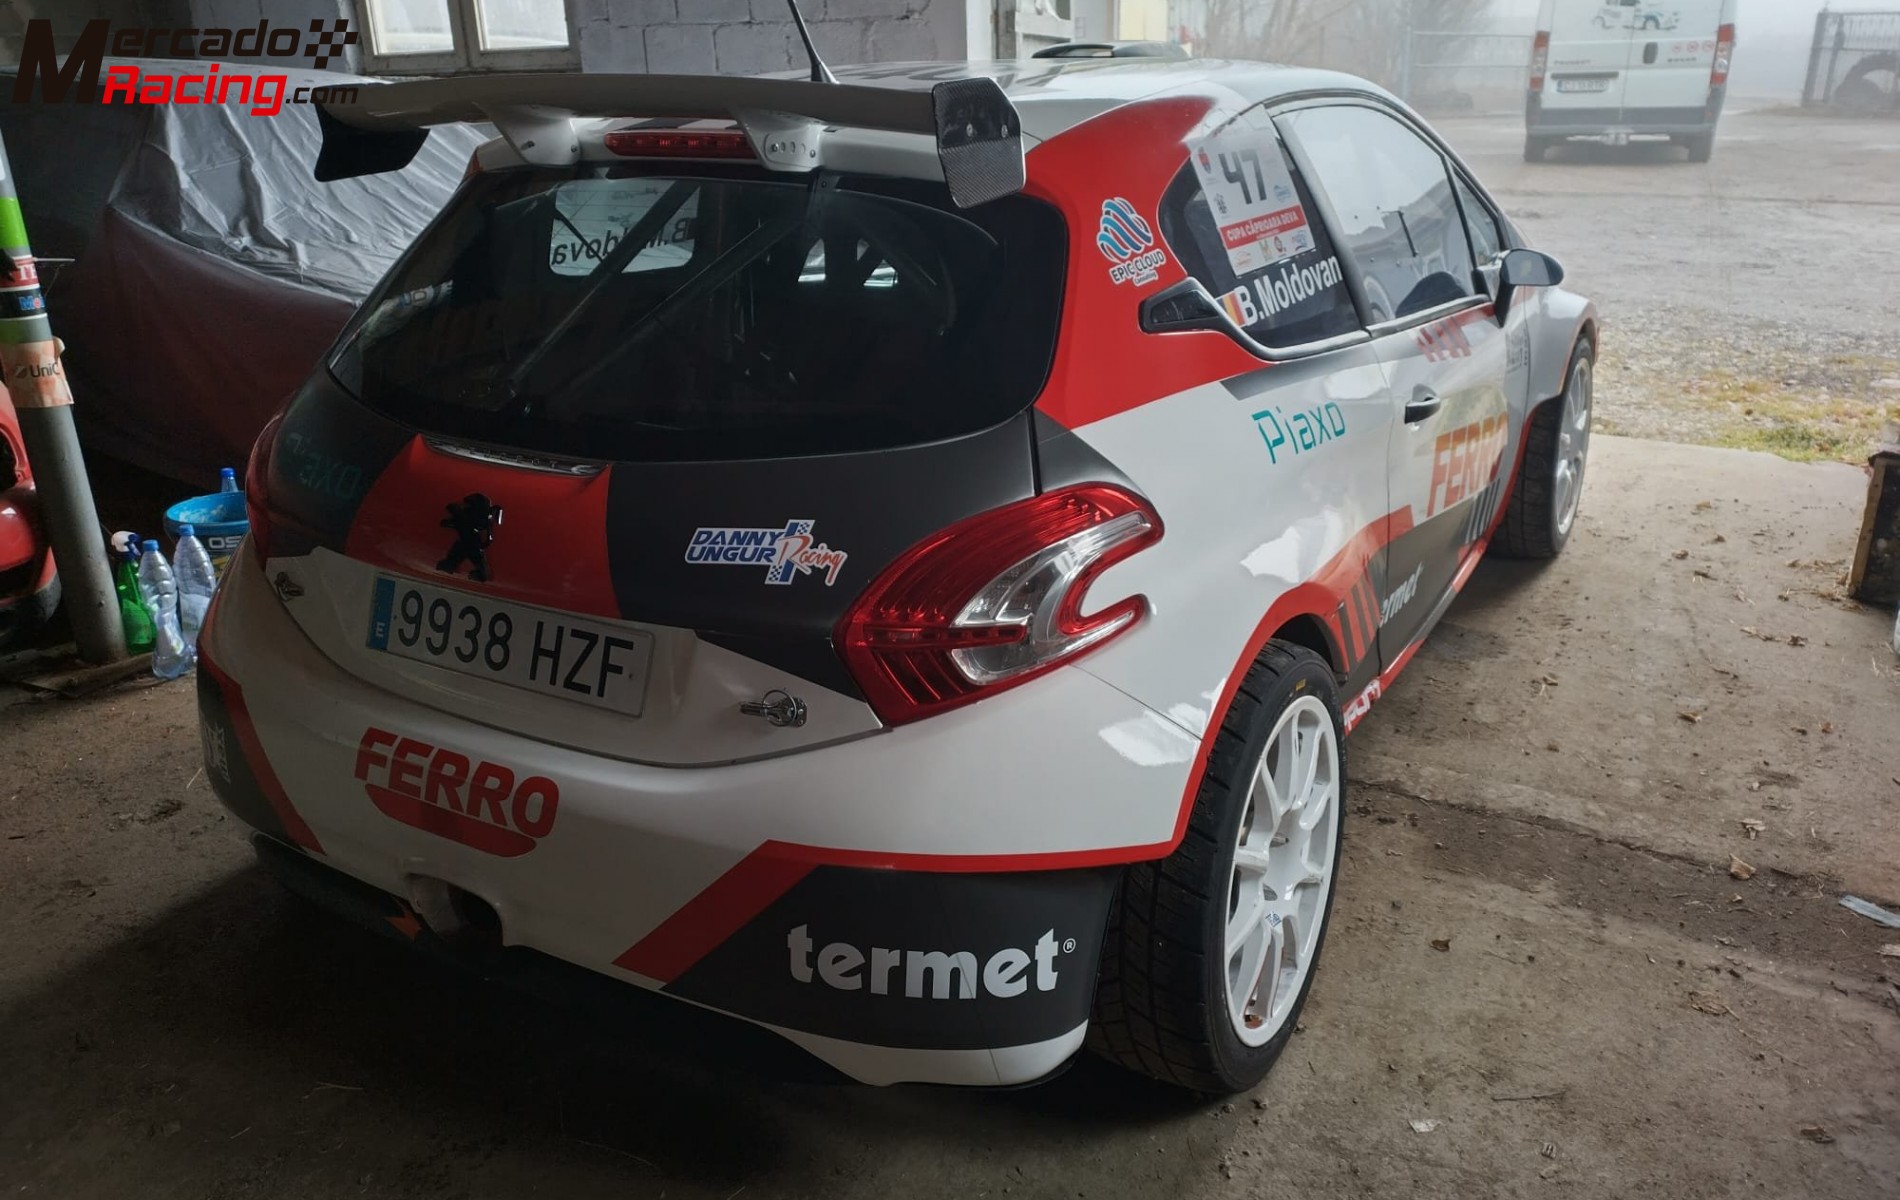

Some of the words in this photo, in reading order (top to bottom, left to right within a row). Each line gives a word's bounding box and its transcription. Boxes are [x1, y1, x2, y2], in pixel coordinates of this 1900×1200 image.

[1218, 149, 1267, 204] 47
[1110, 262, 1135, 282] EPIC
[1134, 250, 1165, 272] CLOUD
[1236, 256, 1343, 326] B.Moldovan
[1251, 402, 1346, 464] Piaxo
[687, 546, 777, 563] UNGUR
[691, 530, 788, 546] DANNY
[777, 534, 843, 584] Racing
[374, 621, 384, 639] E
[396, 589, 514, 672] 9938
[529, 620, 634, 699] HZF
[353, 726, 560, 840] FERRO
